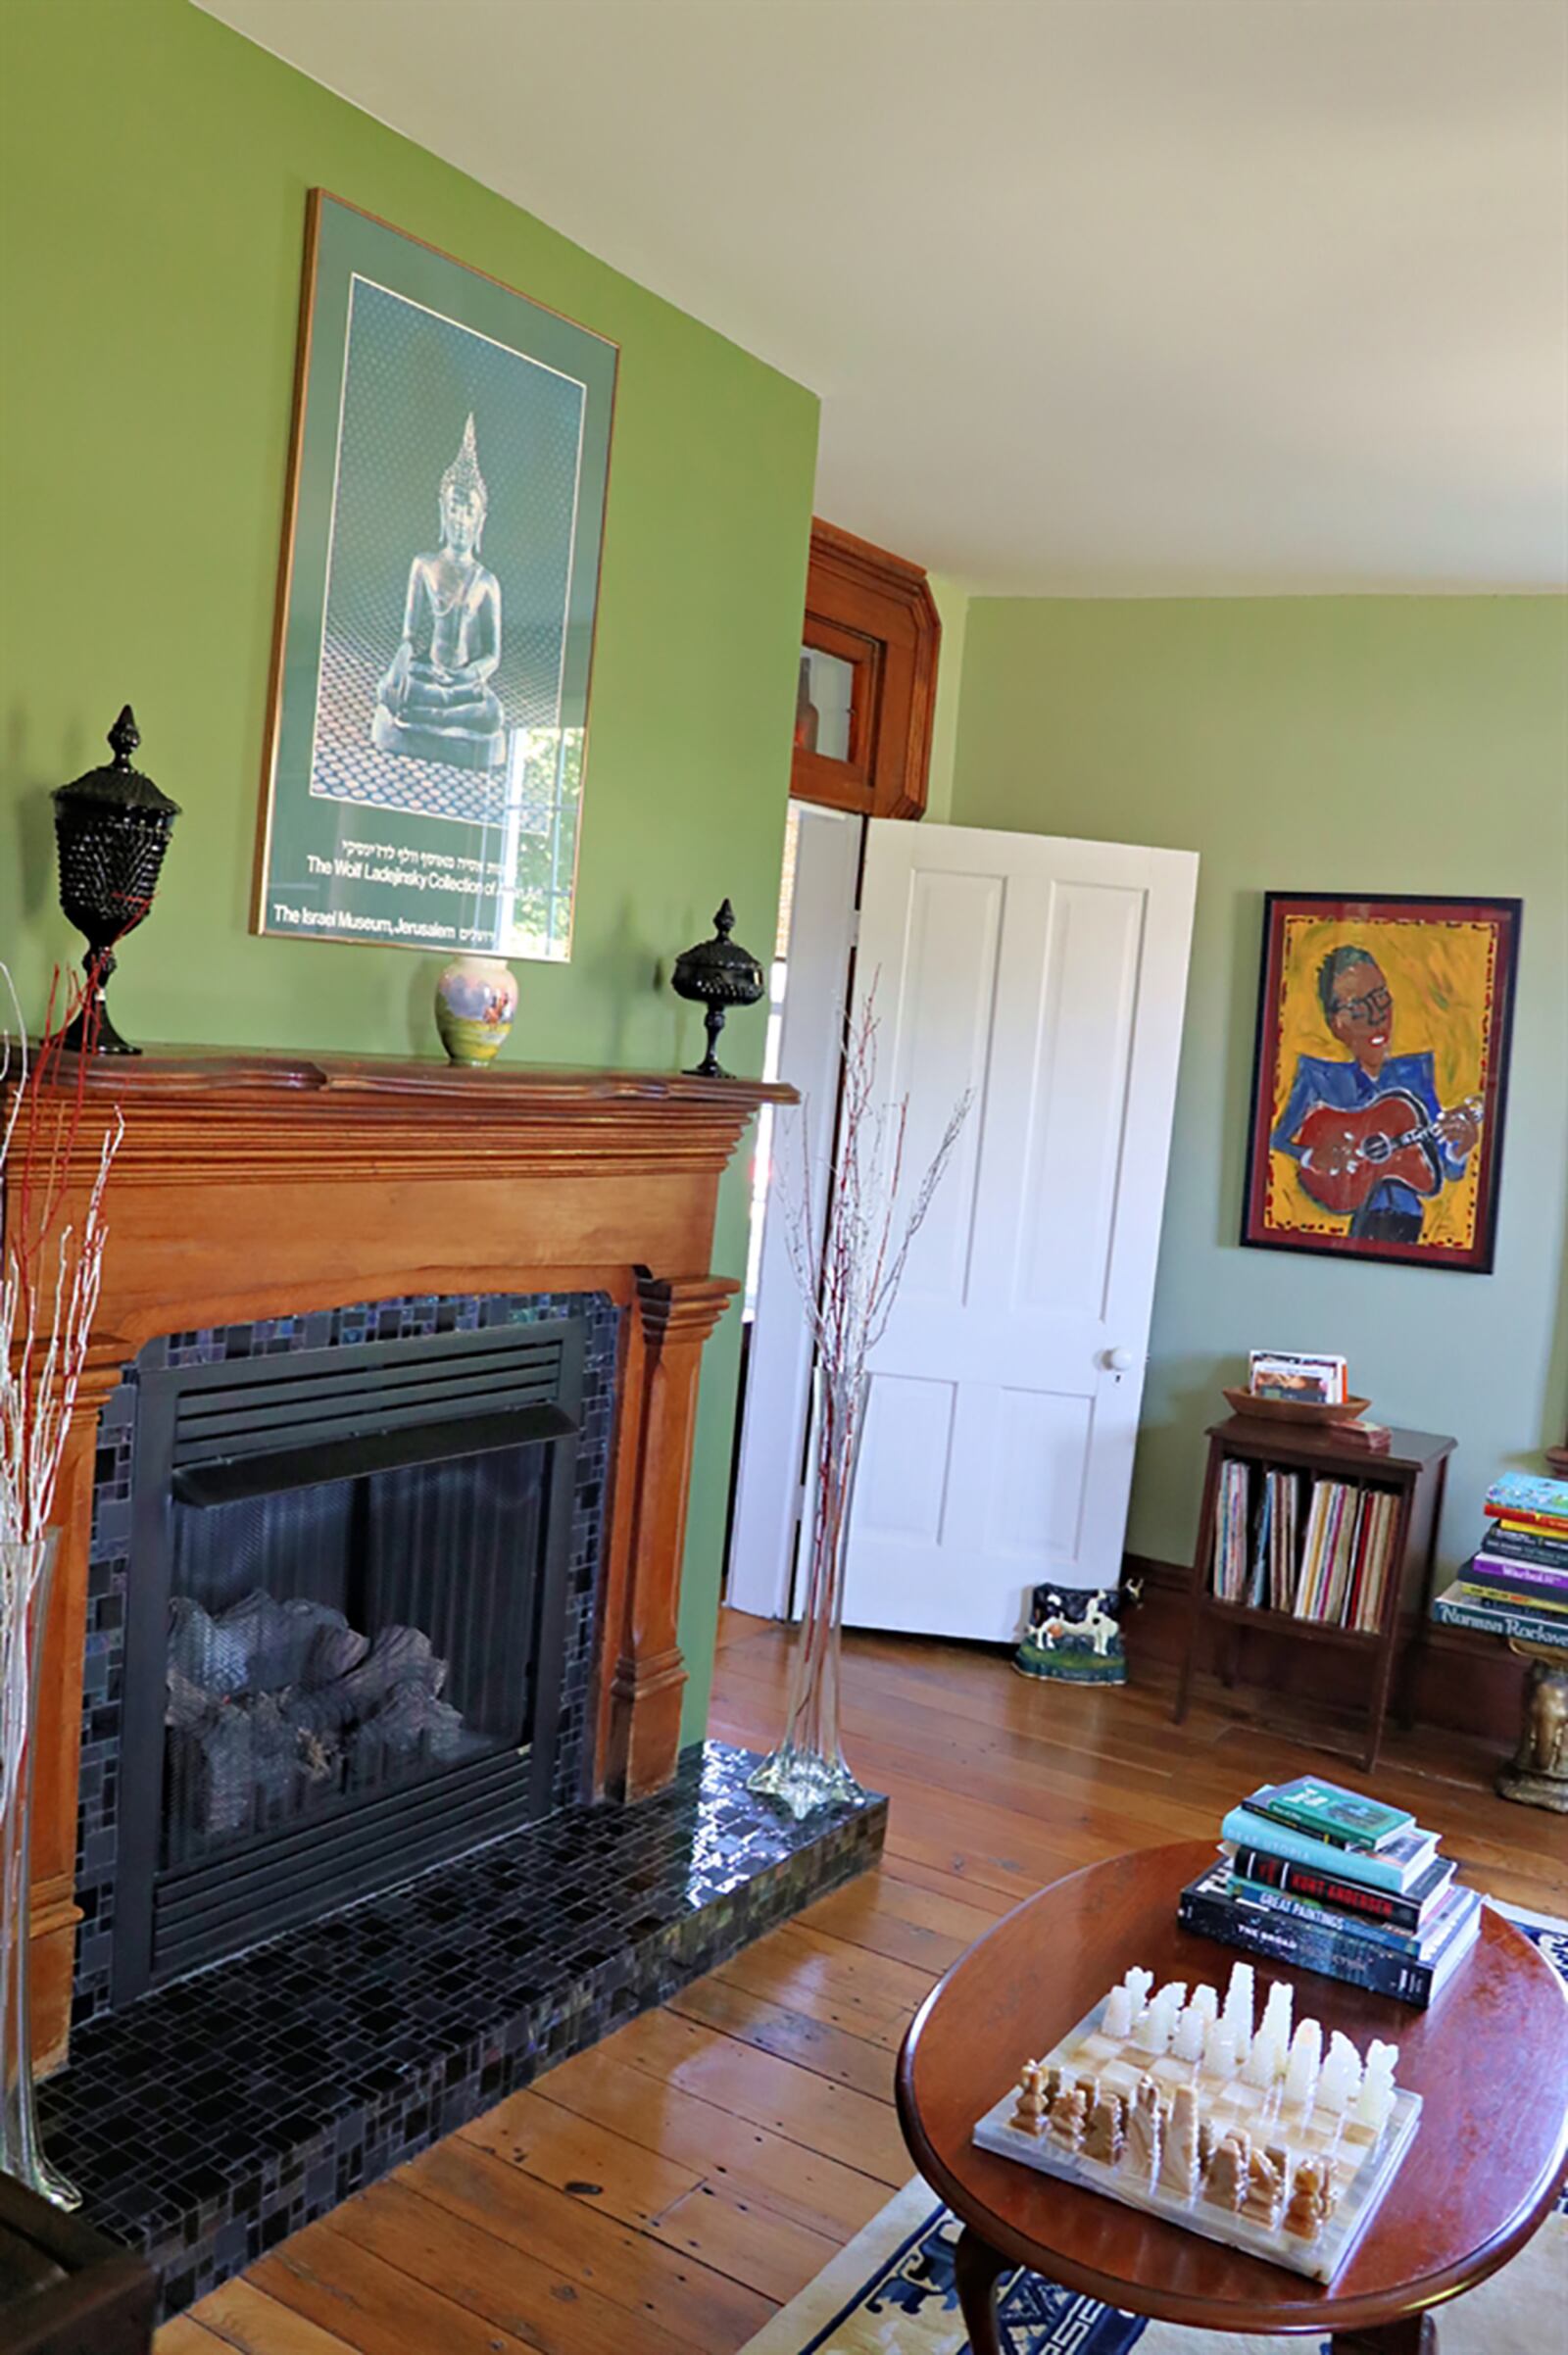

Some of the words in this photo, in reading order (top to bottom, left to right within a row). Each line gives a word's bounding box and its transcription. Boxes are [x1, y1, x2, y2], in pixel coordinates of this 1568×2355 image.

[307, 855, 332, 874] The
[333, 859, 363, 879] Wolf
[428, 871, 482, 894] Collection
[484, 879, 497, 896] of
[273, 904, 300, 923] The
[301, 907, 336, 926] Israel
[338, 910, 394, 936] Museum,
[394, 916, 456, 940] Jerusalem
[1439, 1604, 1503, 1634] Norman
[1291, 1873, 1325, 1895] KURT
[1259, 1891, 1292, 1914] GREAT
[1292, 1900, 1345, 1932] PAINTINGS
[1238, 1923, 1258, 1938] THE
